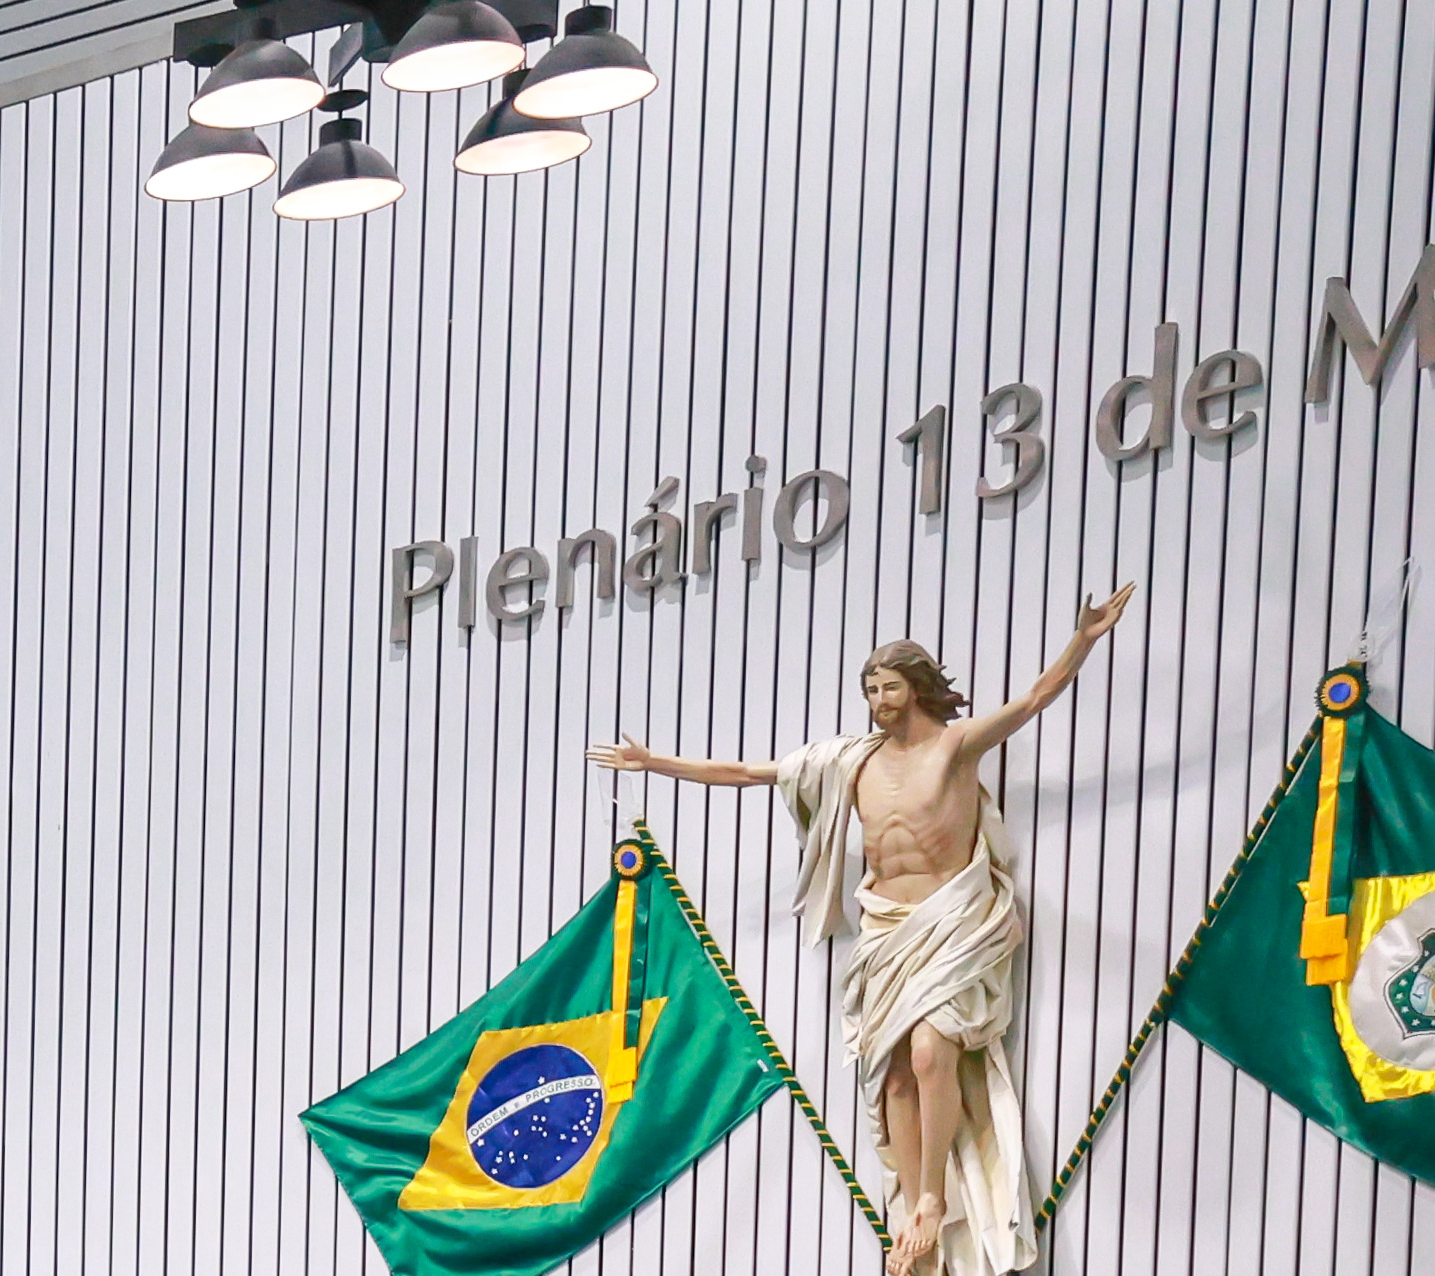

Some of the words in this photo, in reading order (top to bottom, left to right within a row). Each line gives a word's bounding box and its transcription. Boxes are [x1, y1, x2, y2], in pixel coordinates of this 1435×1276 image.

[389, 454, 851, 644] Plenário
[896, 381, 1048, 516] 13
[1096, 321, 1264, 463] de
[470, 1107, 509, 1137] ORDEM
[525, 1078, 593, 1102] PROGRESSO
